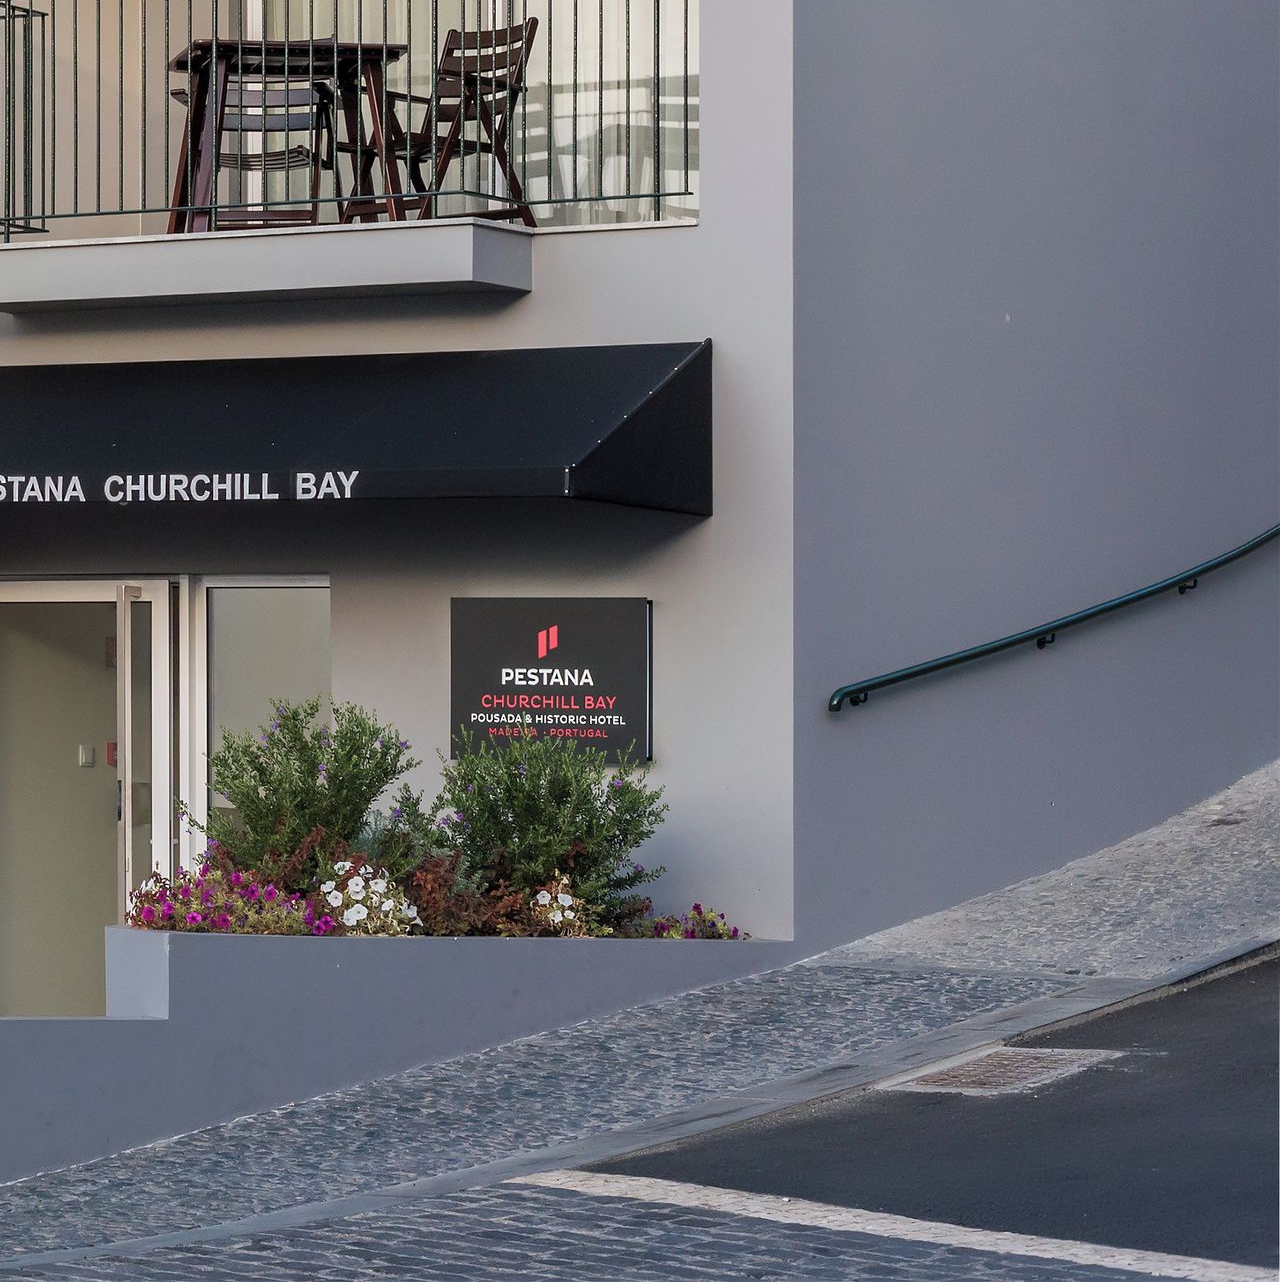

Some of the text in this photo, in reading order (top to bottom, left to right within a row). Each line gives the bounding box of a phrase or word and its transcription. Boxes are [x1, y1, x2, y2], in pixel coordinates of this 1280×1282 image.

[103, 472, 280, 501] CHURCHILL
[296, 470, 359, 500] BAY
[501, 667, 595, 687] PESTANA
[481, 694, 617, 710] CHURCHILL BAY
[470, 713, 627, 726] POUSADA & HISTORIC HOTEL
[488, 727, 538, 737] MADEA
[549, 728, 609, 738] PORTUGAL
